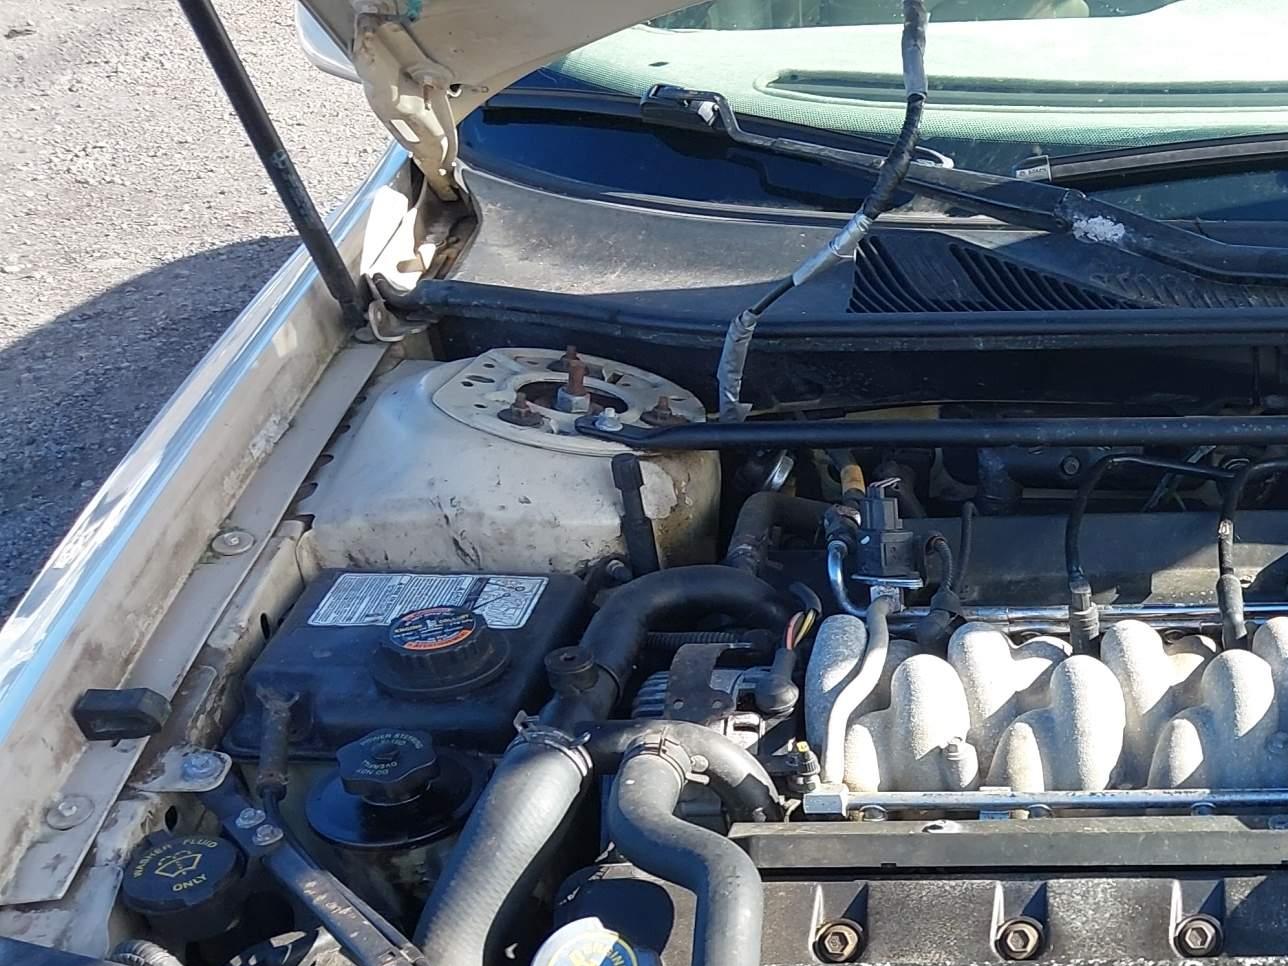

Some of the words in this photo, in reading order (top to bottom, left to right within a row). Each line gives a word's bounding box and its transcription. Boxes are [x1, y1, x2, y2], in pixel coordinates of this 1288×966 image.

[133, 844, 173, 878] WASHER
[183, 838, 218, 848] FLUID
[172, 874, 208, 892] ONLY
